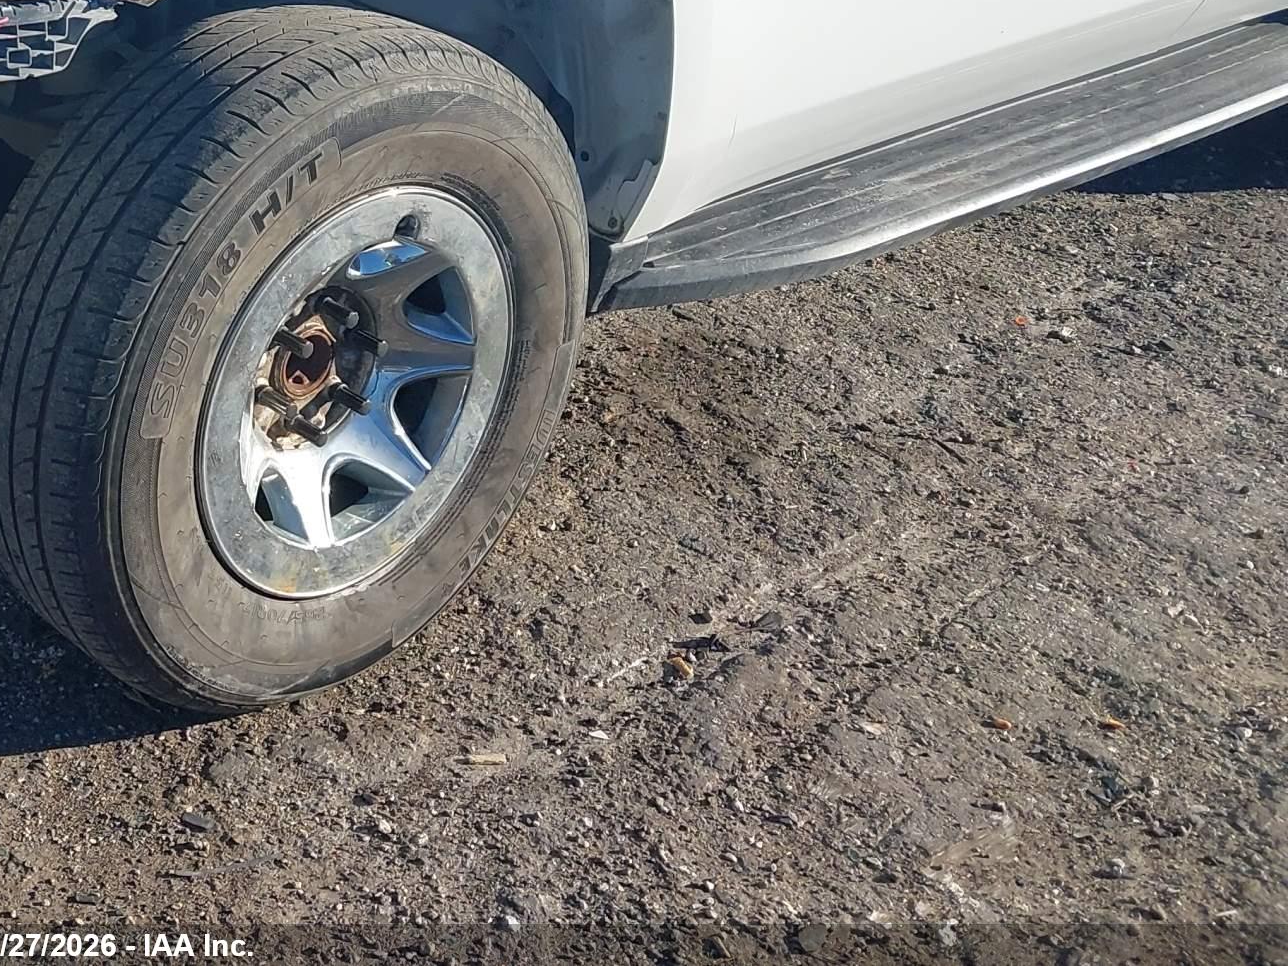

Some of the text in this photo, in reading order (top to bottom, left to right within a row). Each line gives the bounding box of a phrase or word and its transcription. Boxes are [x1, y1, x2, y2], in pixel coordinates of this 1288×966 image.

[150, 153, 323, 419] SU318 H/T
[457, 408, 556, 571] WESTLAKE
